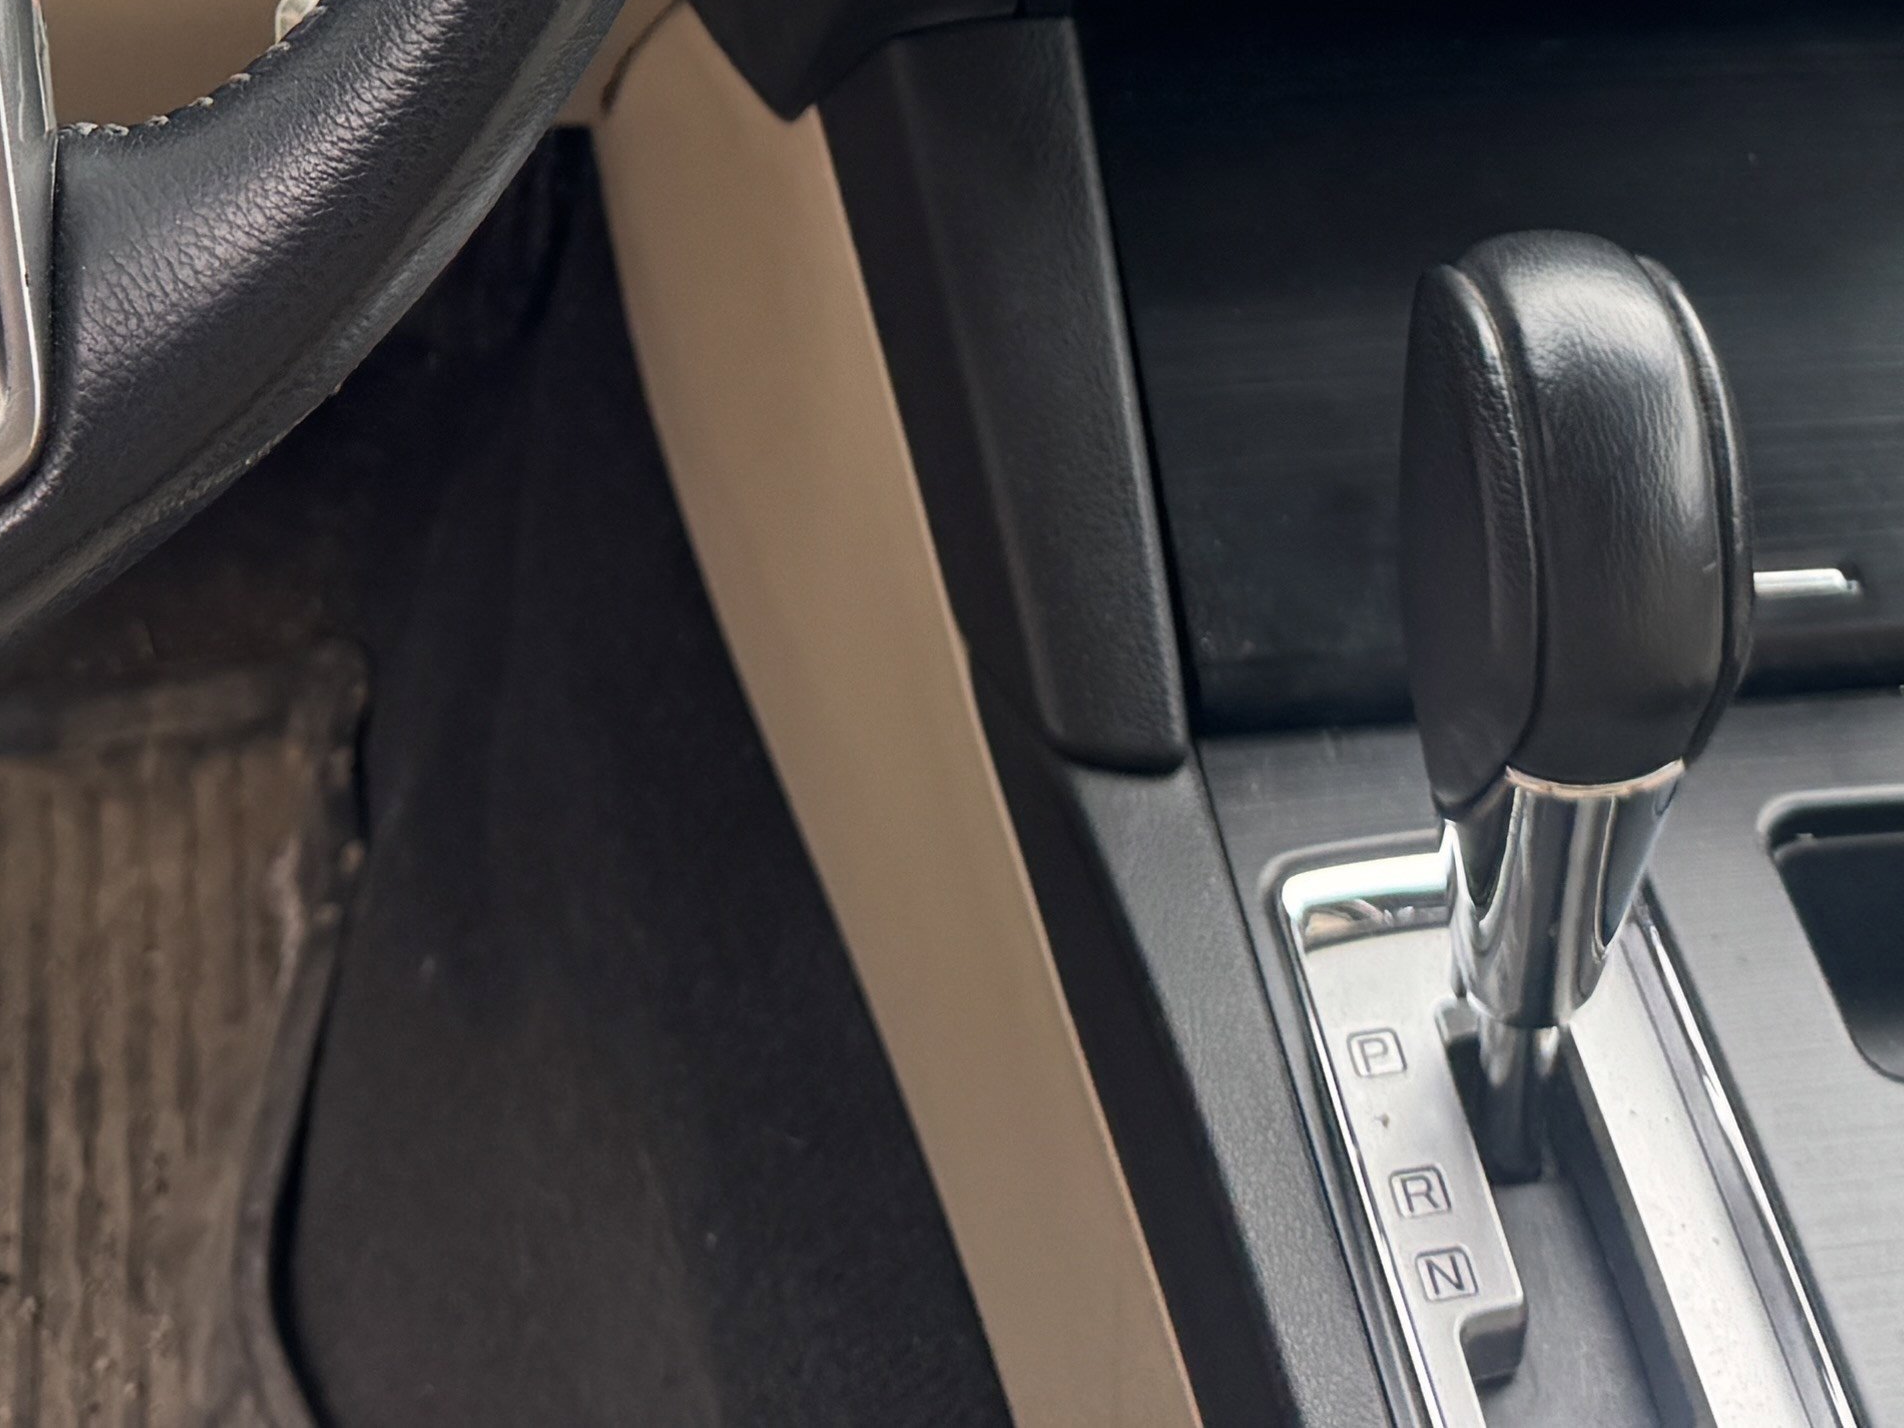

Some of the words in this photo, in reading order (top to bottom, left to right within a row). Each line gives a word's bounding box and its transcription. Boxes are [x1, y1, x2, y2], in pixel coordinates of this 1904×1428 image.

[1356, 1037, 1390, 1074] P
[1401, 1173, 1441, 1213] R
[1425, 1255, 1466, 1295] N
